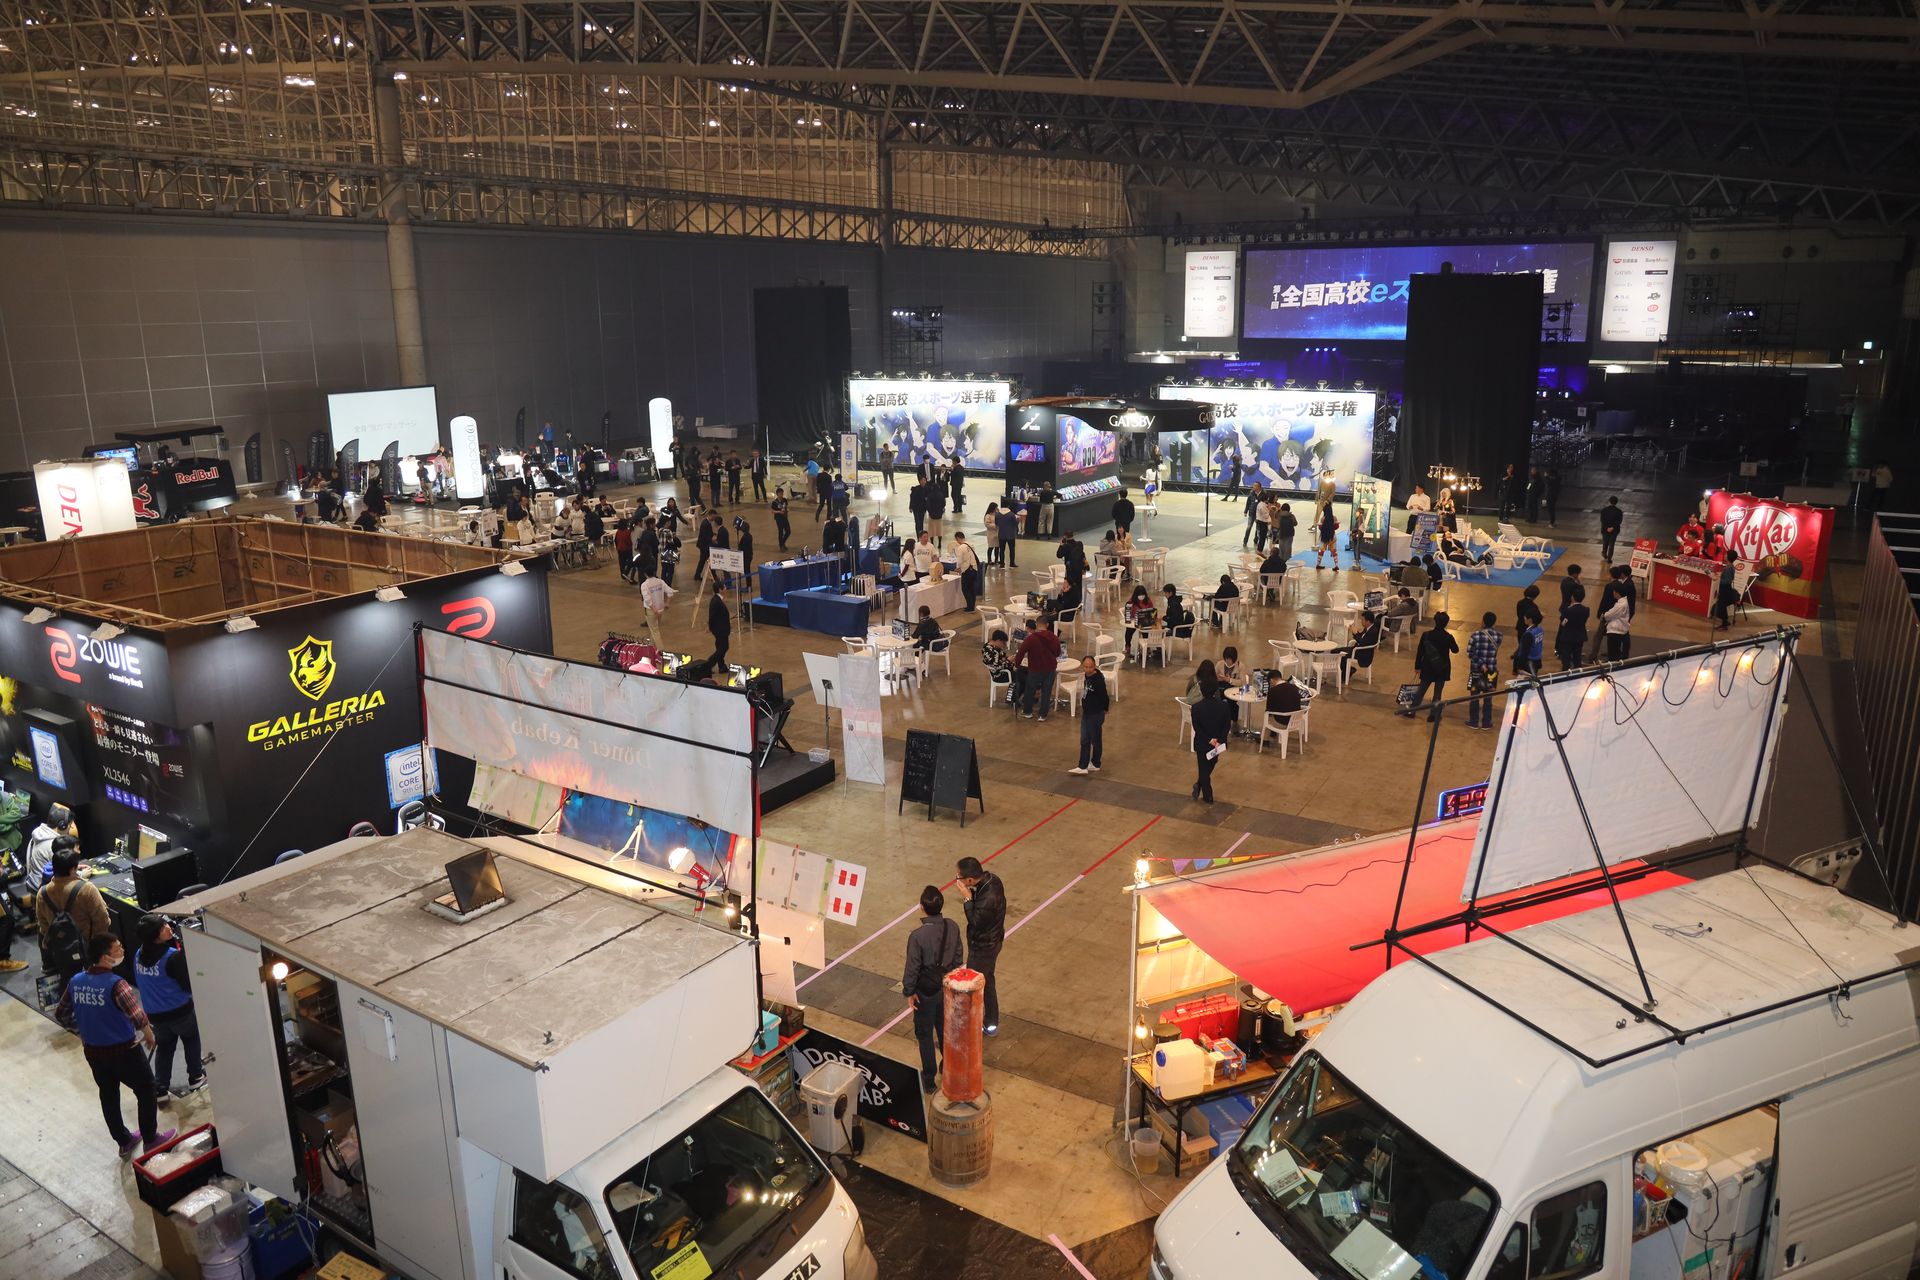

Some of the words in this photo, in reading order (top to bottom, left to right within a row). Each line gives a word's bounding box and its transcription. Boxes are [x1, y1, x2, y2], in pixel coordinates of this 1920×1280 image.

[865, 389, 997, 408] 全国高校eスポーツ選手権
[1108, 414, 1155, 429] GATSBY
[176, 471, 197, 485] Red
[197, 466, 219, 481] Bull
[1730, 508, 1793, 561] KitKat
[76, 633, 141, 675] ZOWIE
[248, 690, 385, 742] GALLERIA
[263, 712, 374, 751] GAMEMASTER
[402, 757, 420, 771] intel
[103, 765, 131, 786] XL2546
[398, 776, 420, 789] CORE
[135, 962, 160, 977] PRESS
[73, 992, 105, 1006] PRESS
